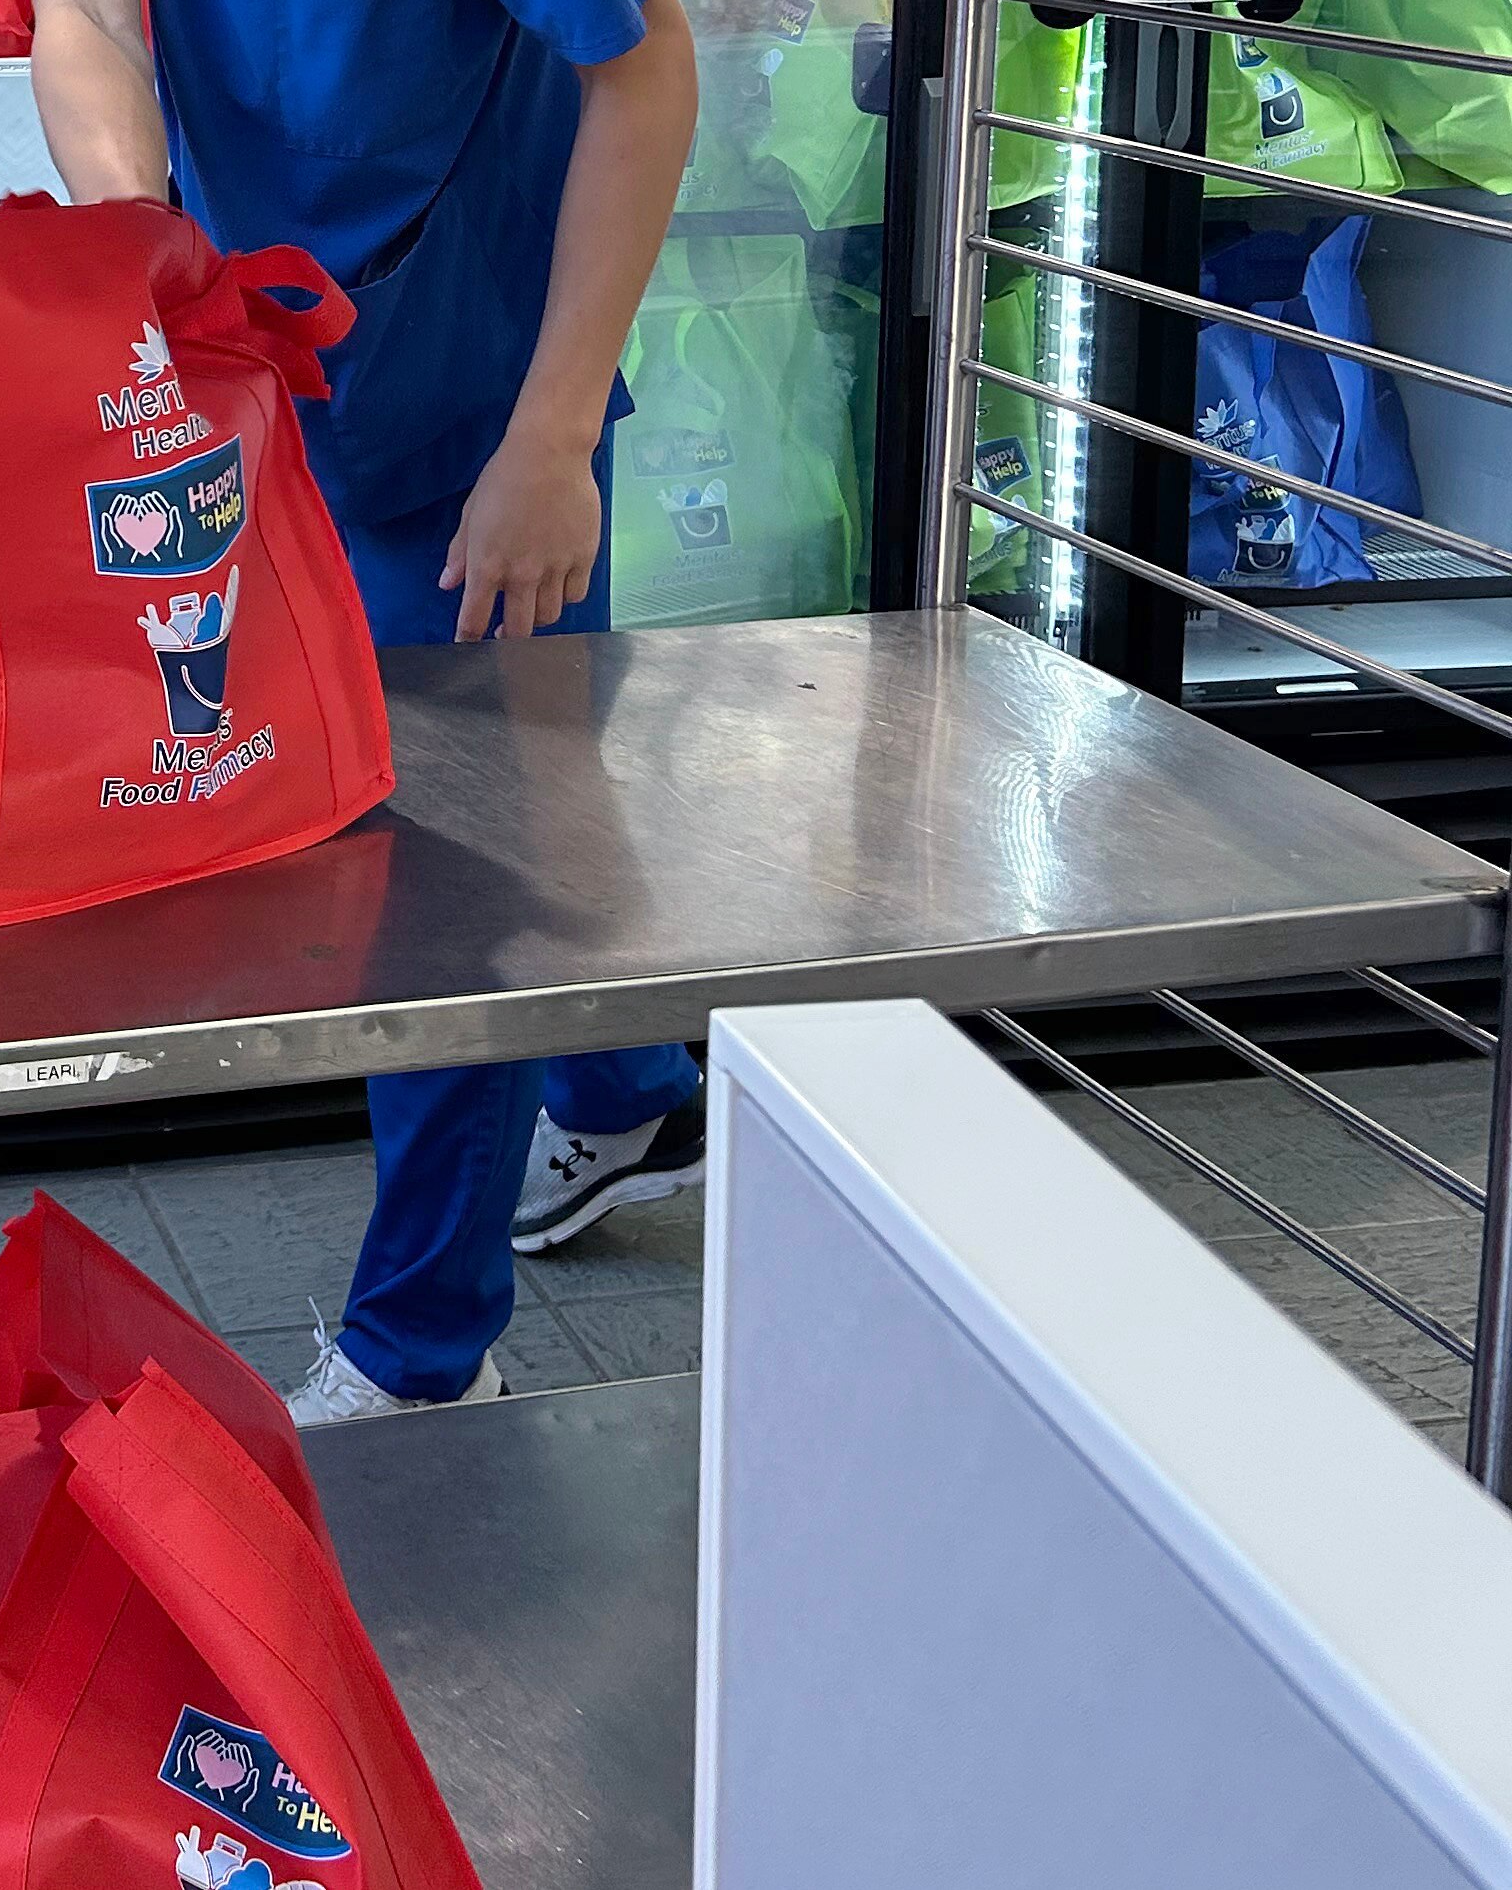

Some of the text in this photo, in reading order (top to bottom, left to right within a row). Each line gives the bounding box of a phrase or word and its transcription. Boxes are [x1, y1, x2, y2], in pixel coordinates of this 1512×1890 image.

[133, 414, 211, 459] Healt
[187, 462, 238, 513] Happy
[991, 461, 1023, 481] Help
[198, 492, 242, 533] To Help
[101, 776, 183, 807] Food
[277, 1795, 342, 1841] To He
